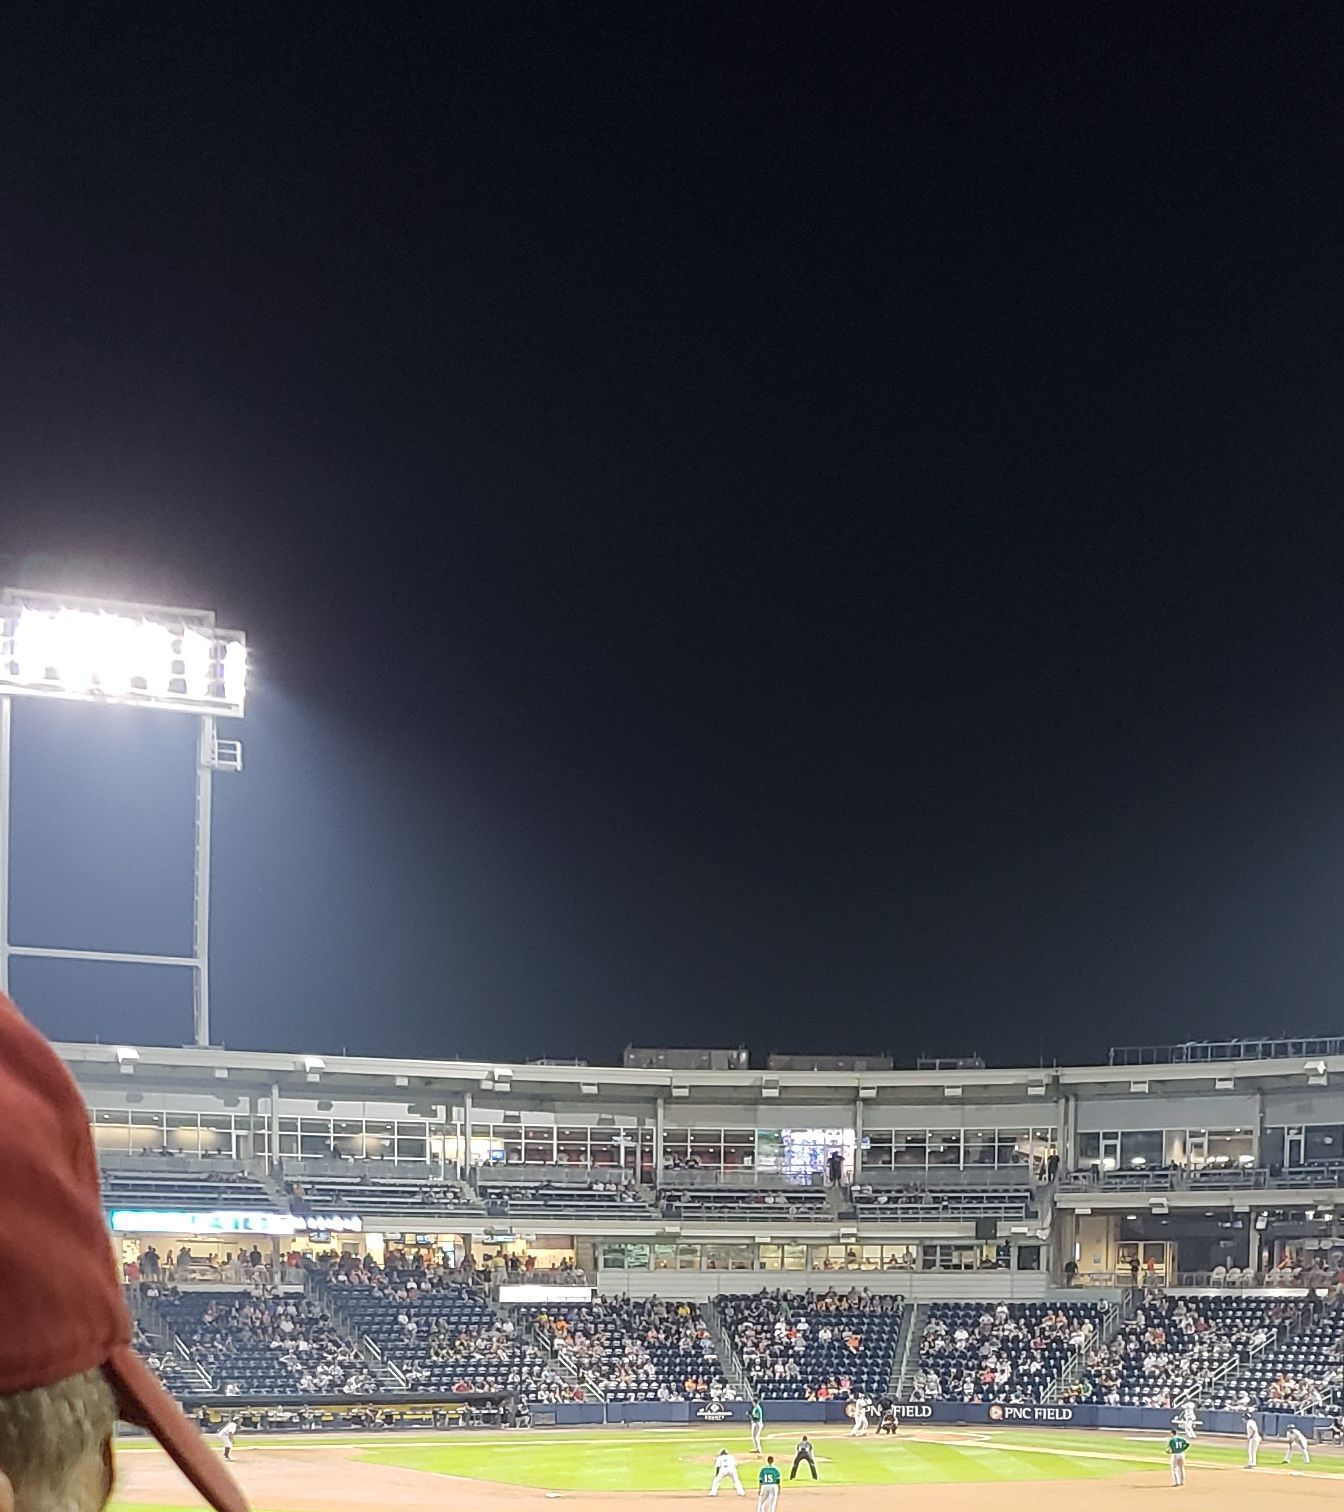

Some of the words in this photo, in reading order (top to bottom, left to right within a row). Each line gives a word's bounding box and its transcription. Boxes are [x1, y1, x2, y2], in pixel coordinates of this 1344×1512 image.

[892, 1405, 932, 1418] FIELD
[1004, 1407, 1032, 1419] PNC
[1033, 1407, 1073, 1420] FIELD
